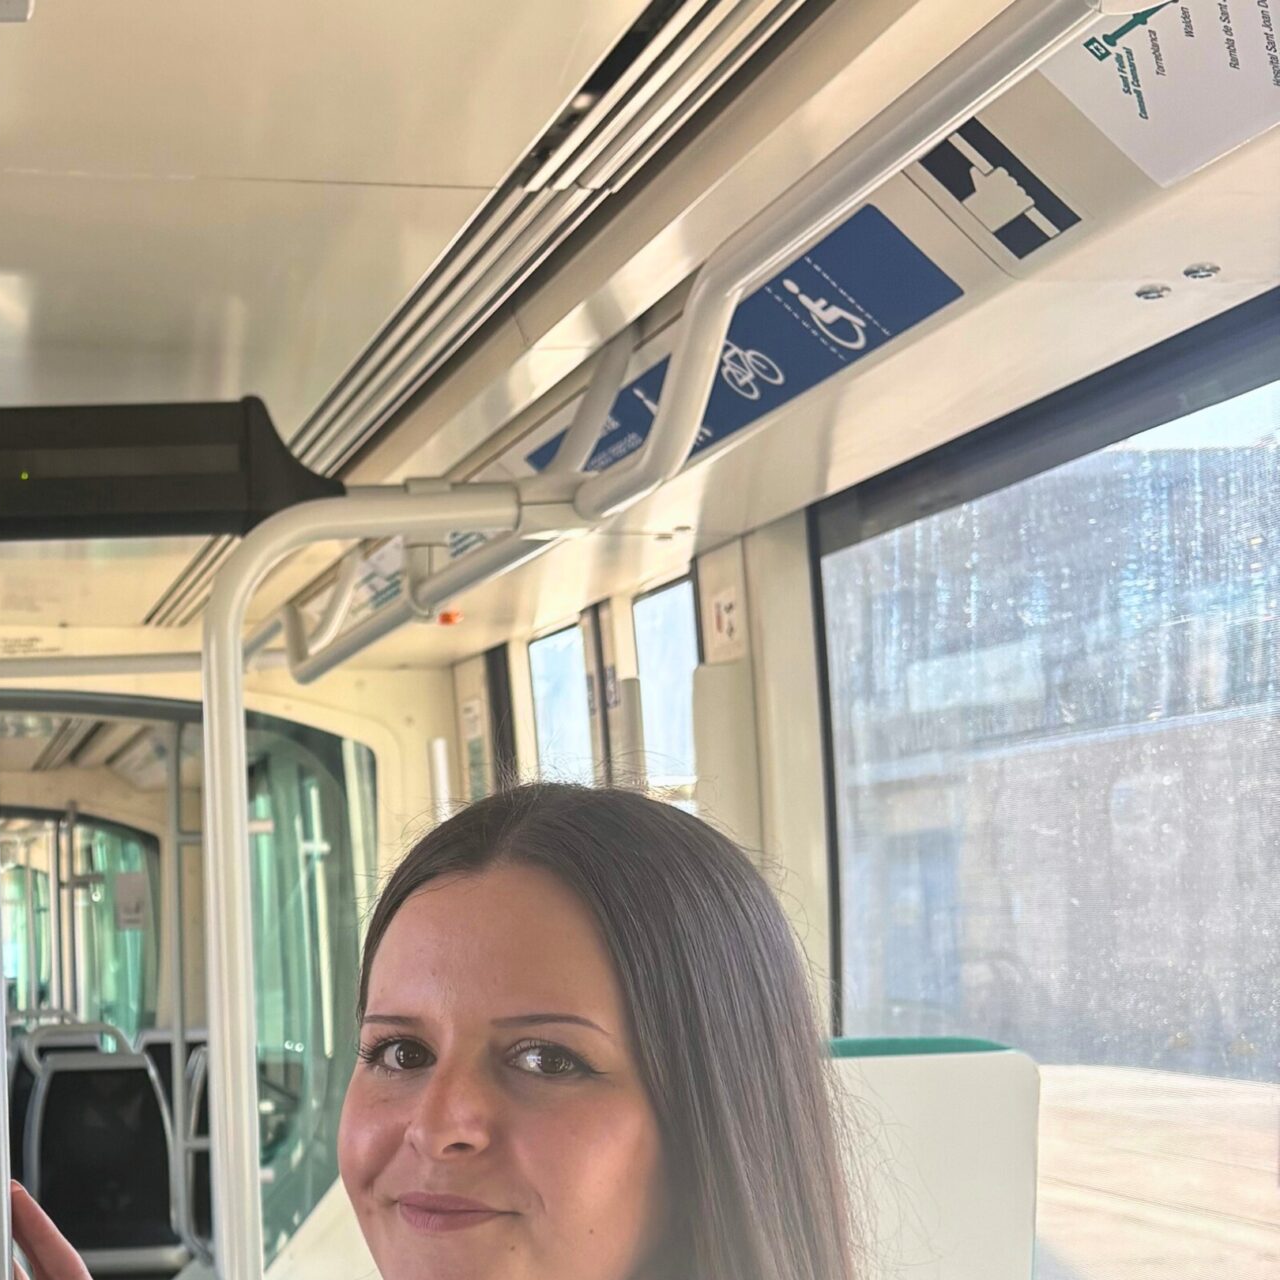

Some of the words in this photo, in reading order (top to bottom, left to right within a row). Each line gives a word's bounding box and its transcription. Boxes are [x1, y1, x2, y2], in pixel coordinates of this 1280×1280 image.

[1181, 6, 1195, 38] Walden
[1217, 3, 1231, 24] Sant
[1261, 10, 1273, 32] Joan
[1222, 25, 1233, 37] de
[1148, 29, 1167, 76] Torreblanca
[1264, 32, 1277, 53] Sant
[1225, 38, 1240, 70] Rambla
